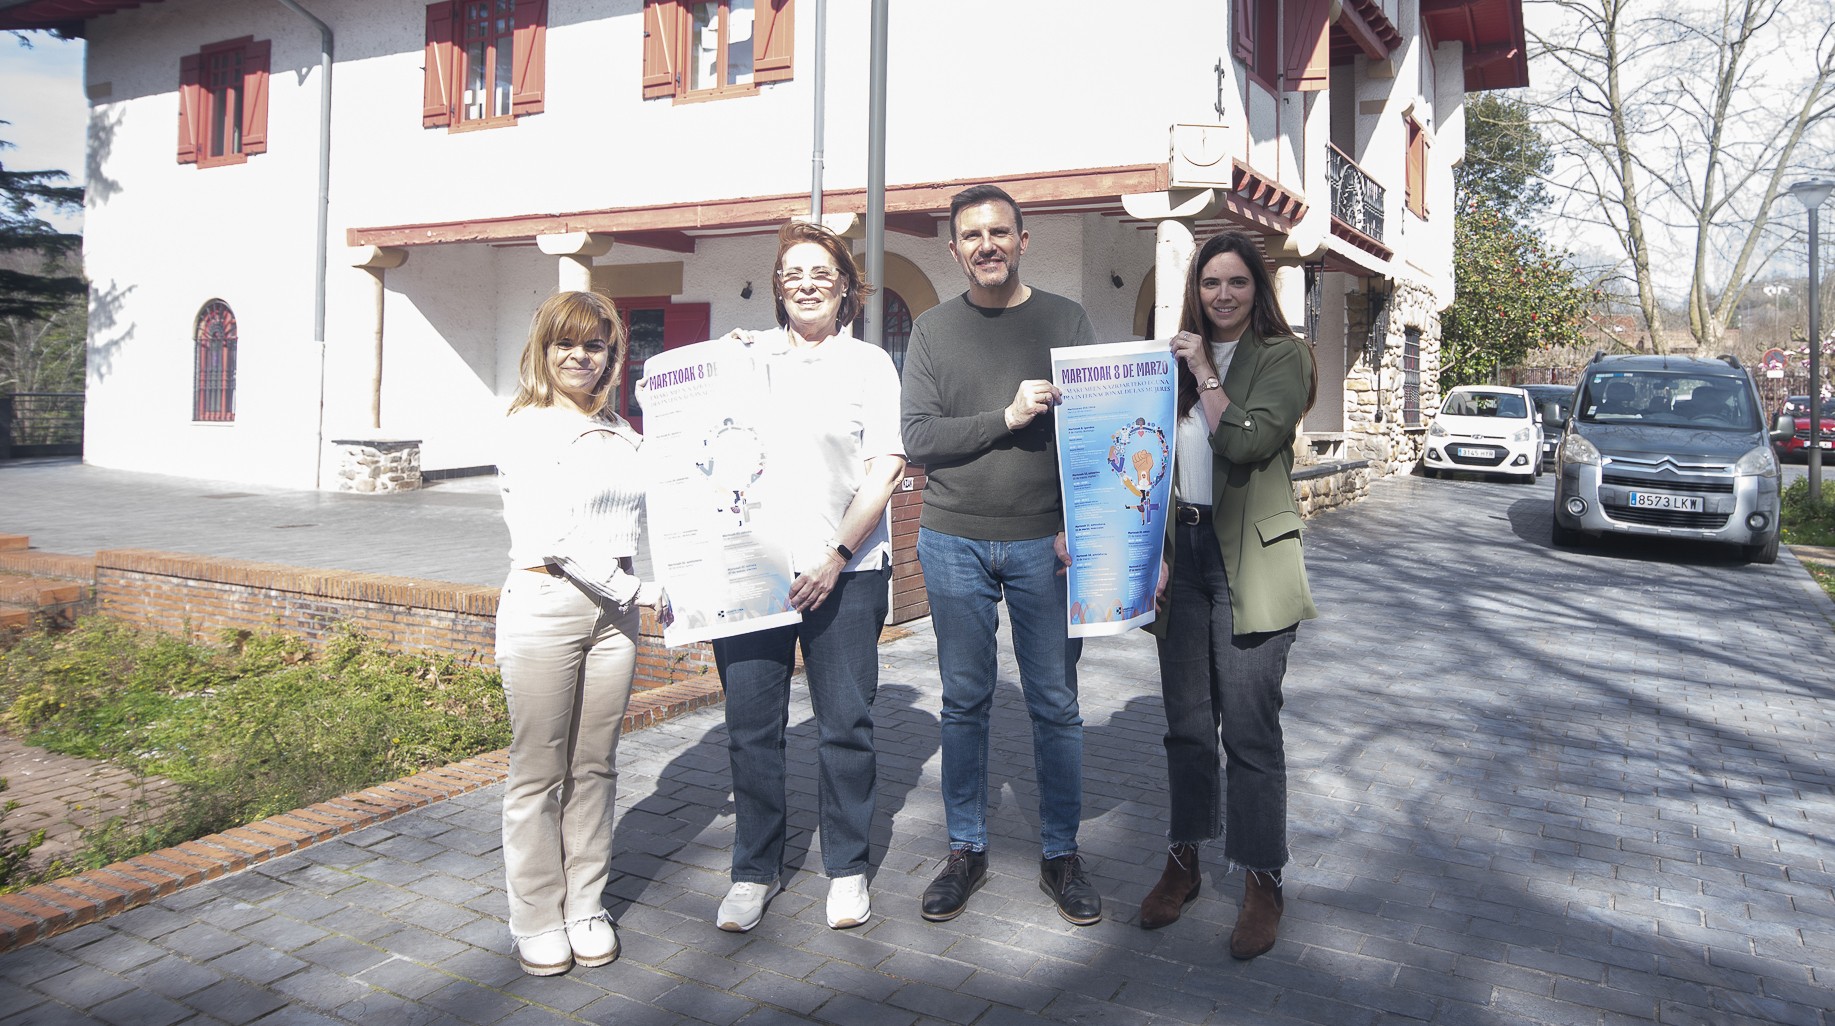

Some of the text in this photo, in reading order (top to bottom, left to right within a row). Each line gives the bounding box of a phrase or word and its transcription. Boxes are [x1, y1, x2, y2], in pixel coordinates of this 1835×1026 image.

[649, 366, 696, 391] MARTXOAK
[697, 364, 704, 379] 8
[1061, 360, 1169, 385] MARTXOAK 8 DE MARZO
[1638, 494, 1698, 511] 8573 LKW
